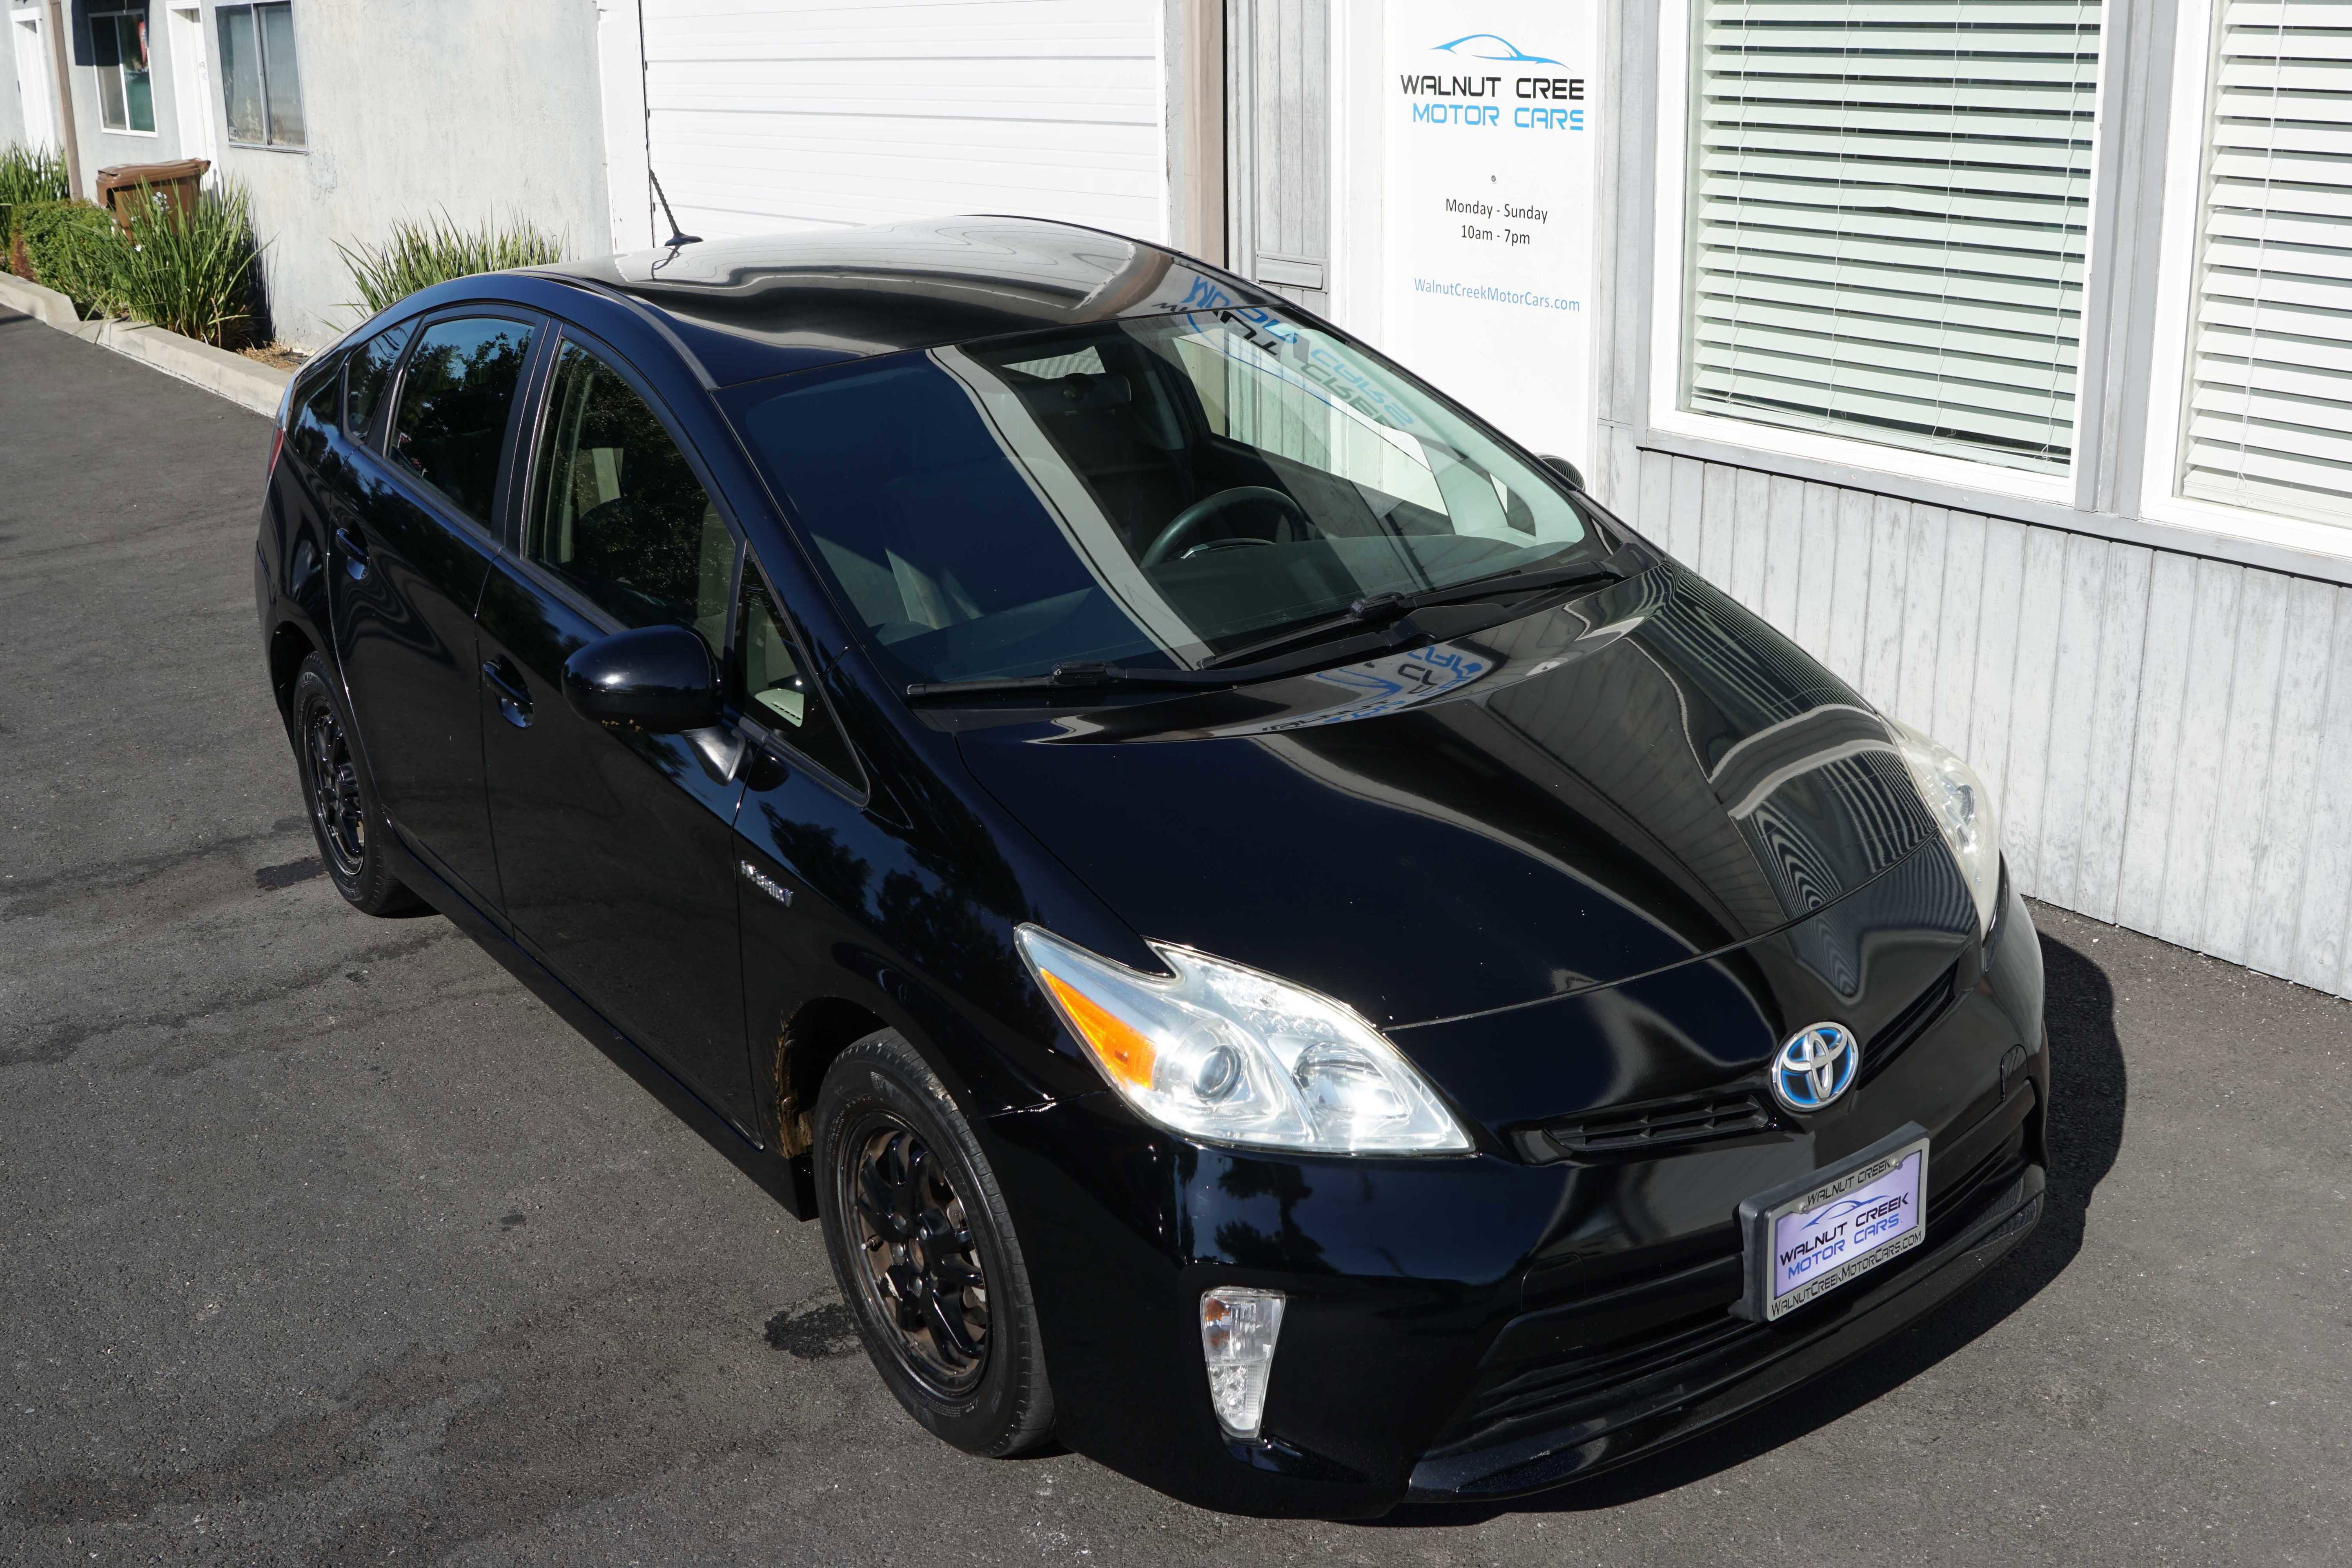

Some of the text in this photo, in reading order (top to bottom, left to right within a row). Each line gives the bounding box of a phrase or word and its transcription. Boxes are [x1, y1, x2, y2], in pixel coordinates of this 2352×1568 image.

[1400, 75, 1501, 97] WALNUT
[1413, 103, 1584, 131] MOTOR CARS
[1446, 198, 1493, 219] Monday
[1504, 204, 1548, 224] Sunday
[1461, 225, 1492, 241] 10am
[1504, 229, 1530, 246] 7pm
[1414, 278, 1579, 312] WalnutCreekMotorCars.com
[1807, 1156, 1892, 1207] WALNUT CREEK
[1780, 1192, 1909, 1266] WALNUT CREEK
[1788, 1213, 1899, 1280] MOTOR CARS
